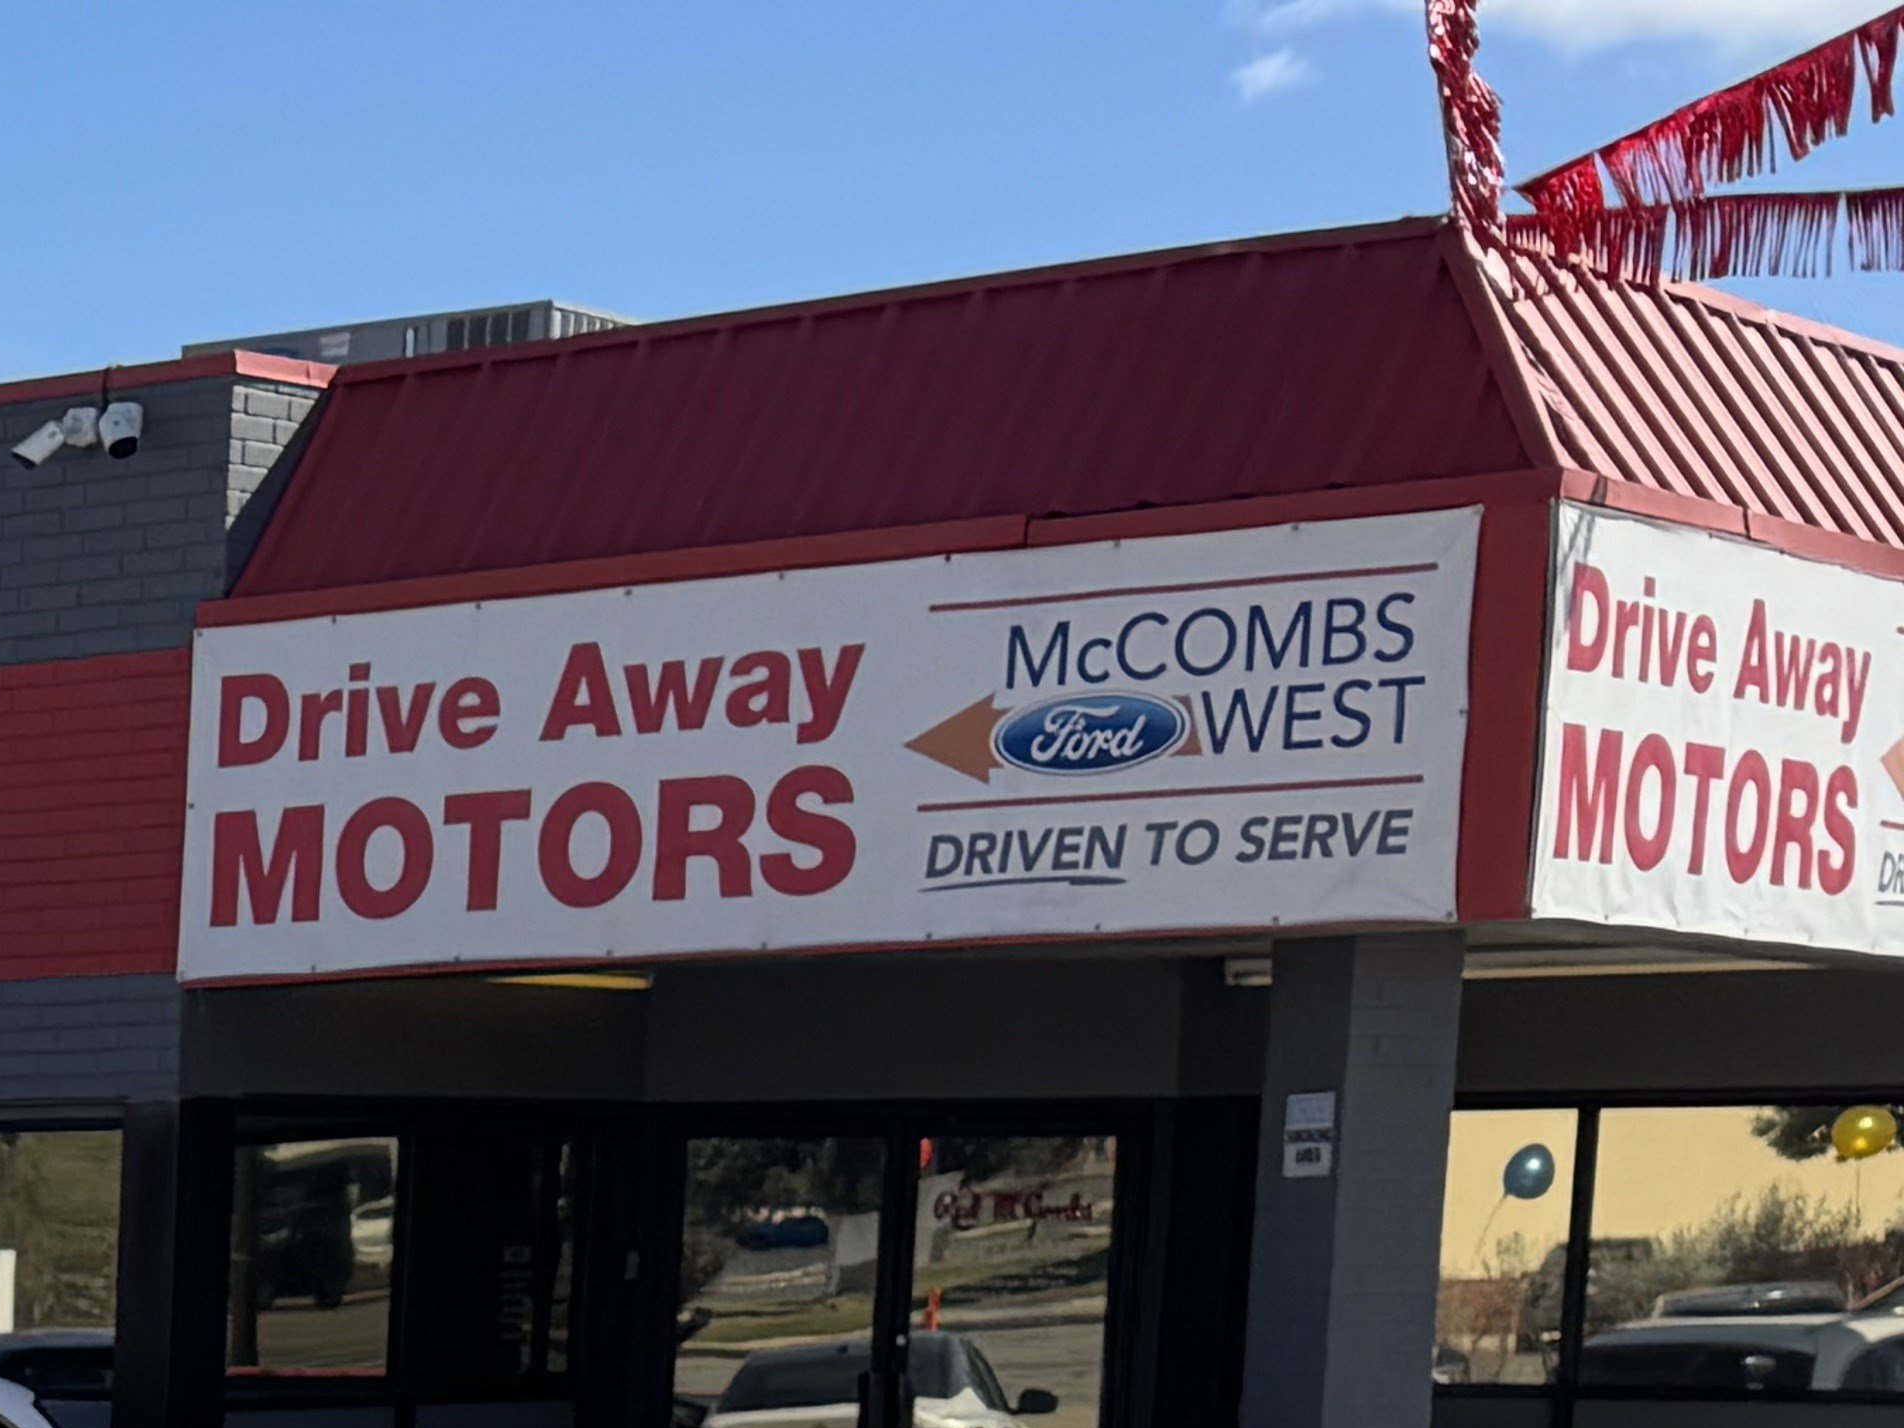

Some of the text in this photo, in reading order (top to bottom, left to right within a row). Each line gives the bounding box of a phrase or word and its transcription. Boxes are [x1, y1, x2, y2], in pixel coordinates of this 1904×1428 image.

[217, 640, 866, 768] Drive Away
[1005, 591, 1416, 690] McCOMBS
[1567, 560, 1872, 744] Drive Away
[1030, 675, 1426, 763] Ford WEST
[209, 764, 857, 927] MOTORS
[924, 808, 1414, 880] DRIVEN TO SERVE
[1553, 722, 1859, 896] MOTORS
